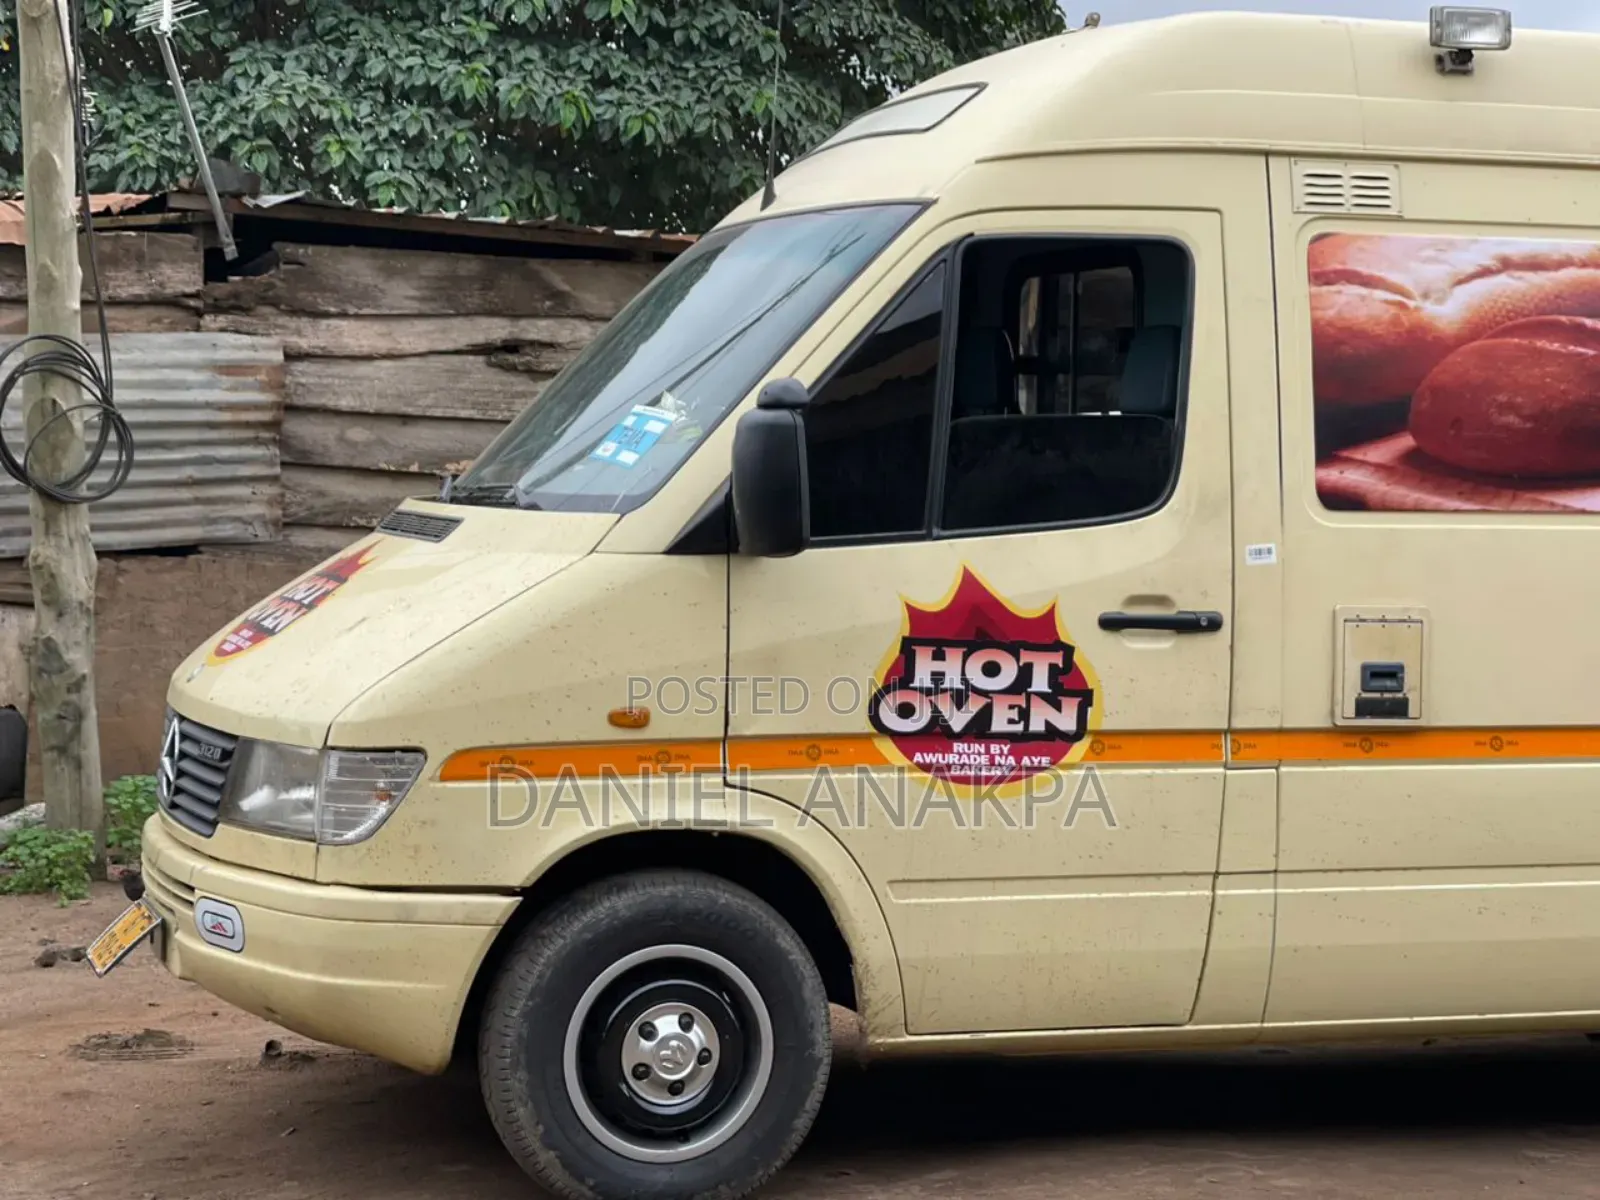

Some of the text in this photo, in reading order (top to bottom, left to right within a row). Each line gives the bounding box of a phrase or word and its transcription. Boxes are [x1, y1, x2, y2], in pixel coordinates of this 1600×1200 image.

[909, 645, 1063, 693] HOT
[878, 689, 1083, 735] OVEN
[953, 742, 1011, 755] RUN BY
[913, 752, 1051, 767] AWURADE NA AYE
[950, 764, 1011, 776] BAKERY
